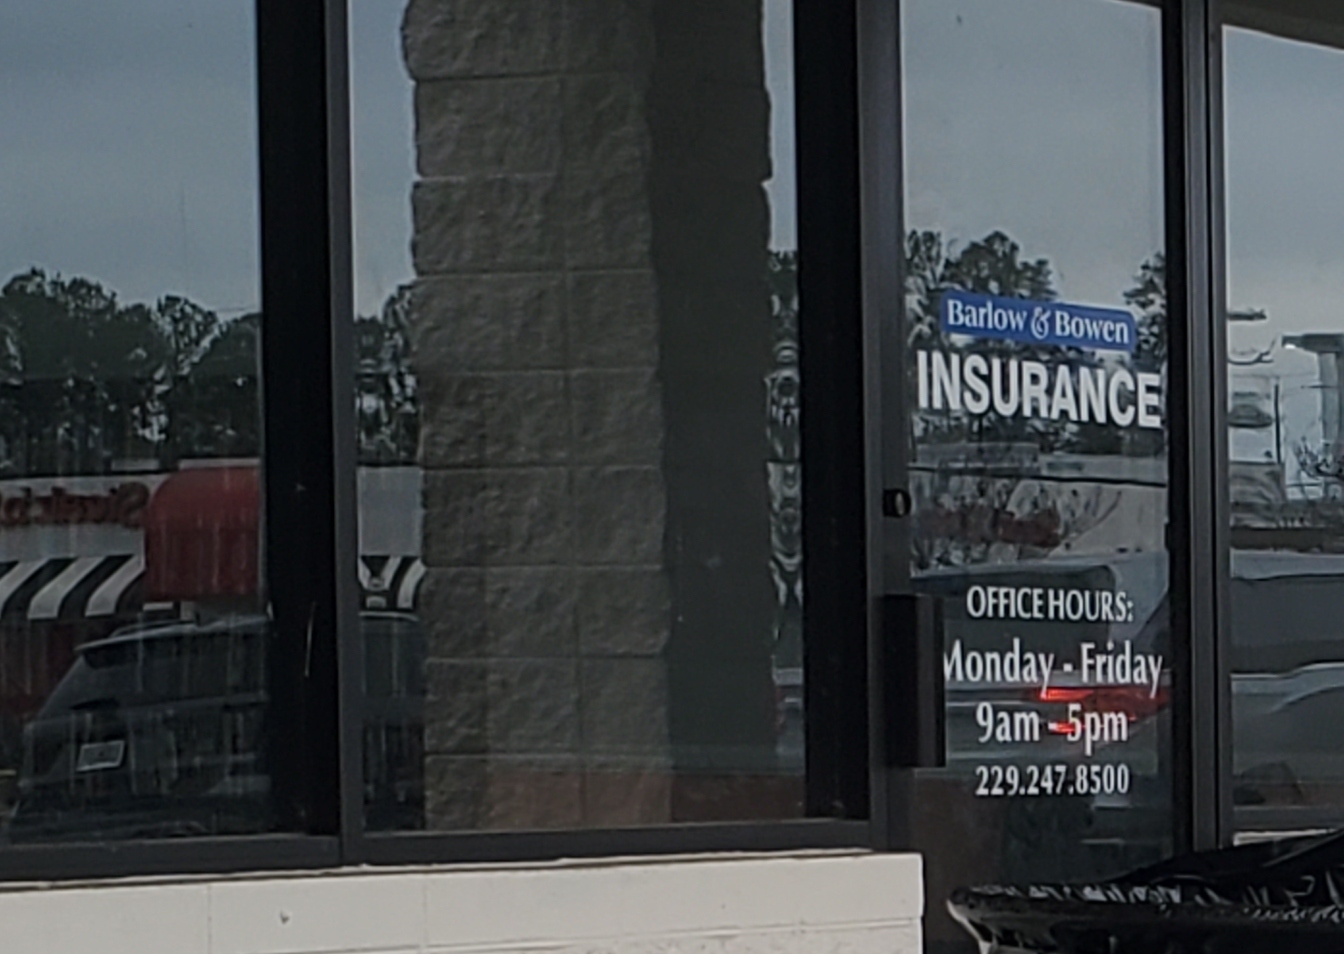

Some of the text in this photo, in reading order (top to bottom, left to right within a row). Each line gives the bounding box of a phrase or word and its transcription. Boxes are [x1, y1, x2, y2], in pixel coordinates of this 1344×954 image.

[947, 299, 1130, 344] Barlow & Bowen
[917, 350, 1162, 429] INSURANCE
[966, 585, 1134, 622] OFFICE HOURS:
[943, 637, 1054, 699] Monday
[1080, 639, 1163, 699] Friday
[976, 701, 1041, 743] 9am
[1066, 703, 1128, 756] 5pm
[974, 764, 1130, 796] 229.247.8500
